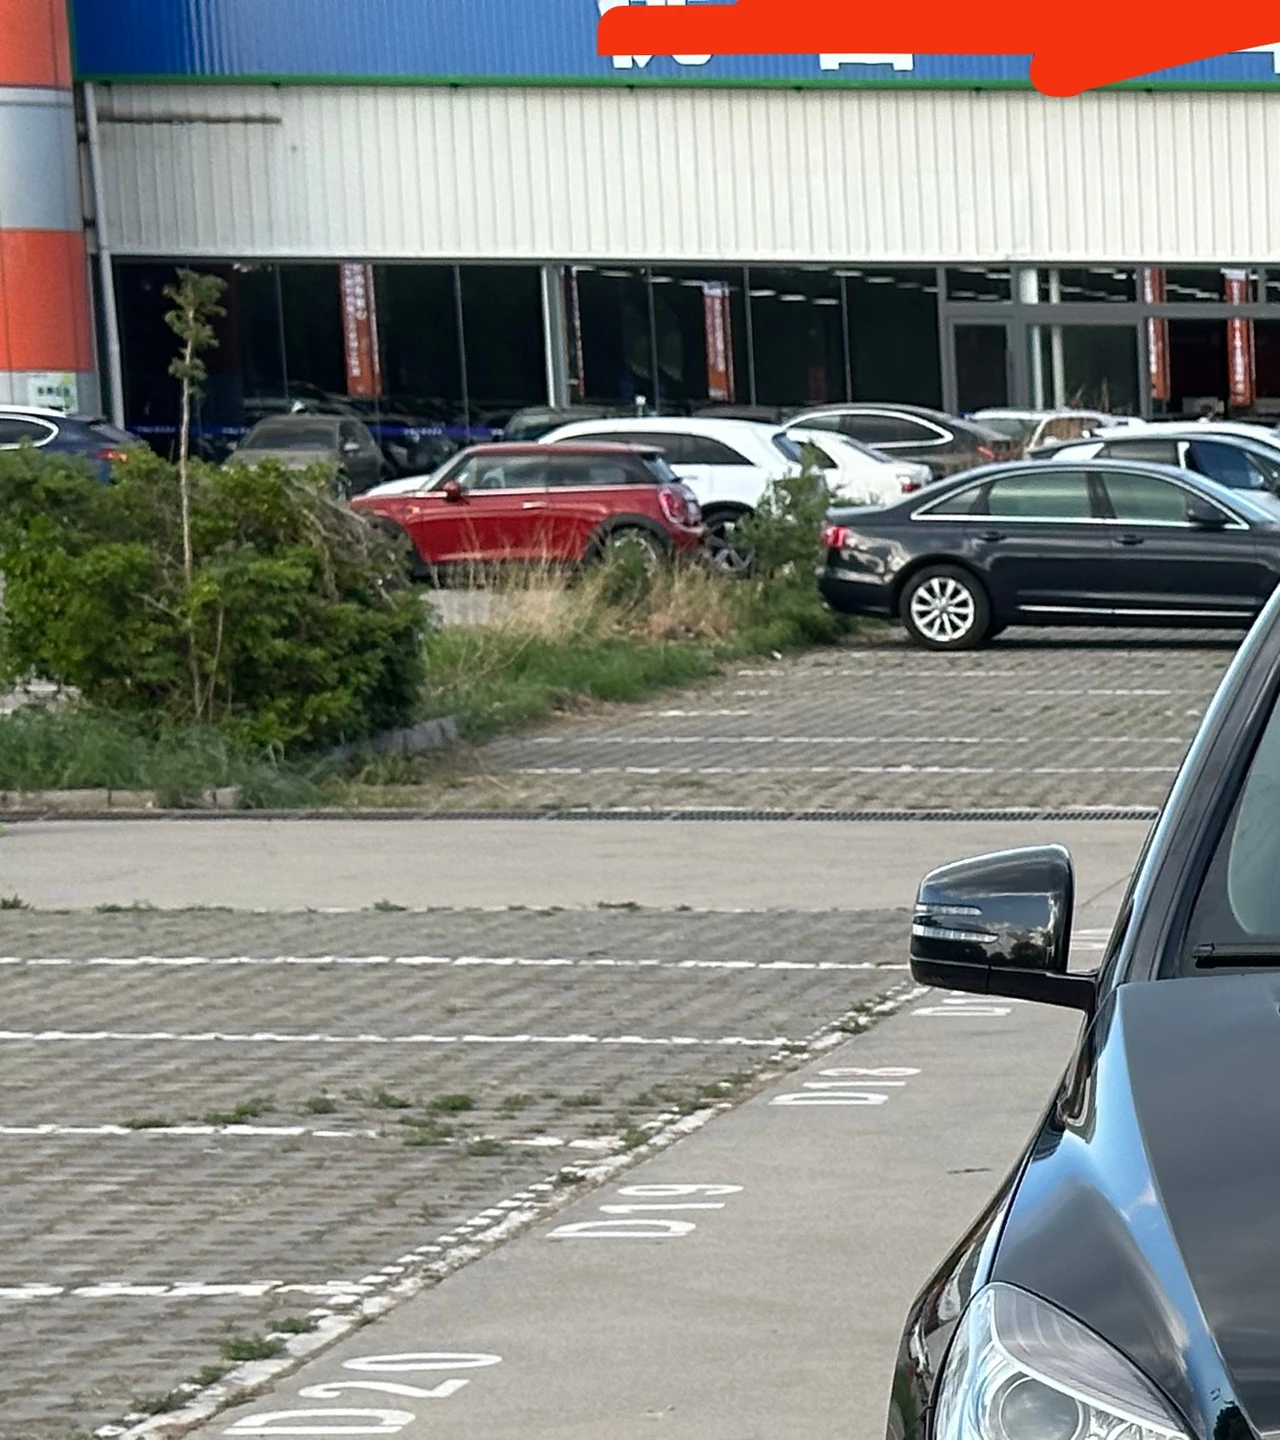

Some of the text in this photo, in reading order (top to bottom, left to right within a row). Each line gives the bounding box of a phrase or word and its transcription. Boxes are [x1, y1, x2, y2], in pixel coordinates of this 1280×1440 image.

[768, 1066, 922, 1106] D18
[546, 1183, 744, 1238] D19
[222, 1351, 502, 1435] D20
